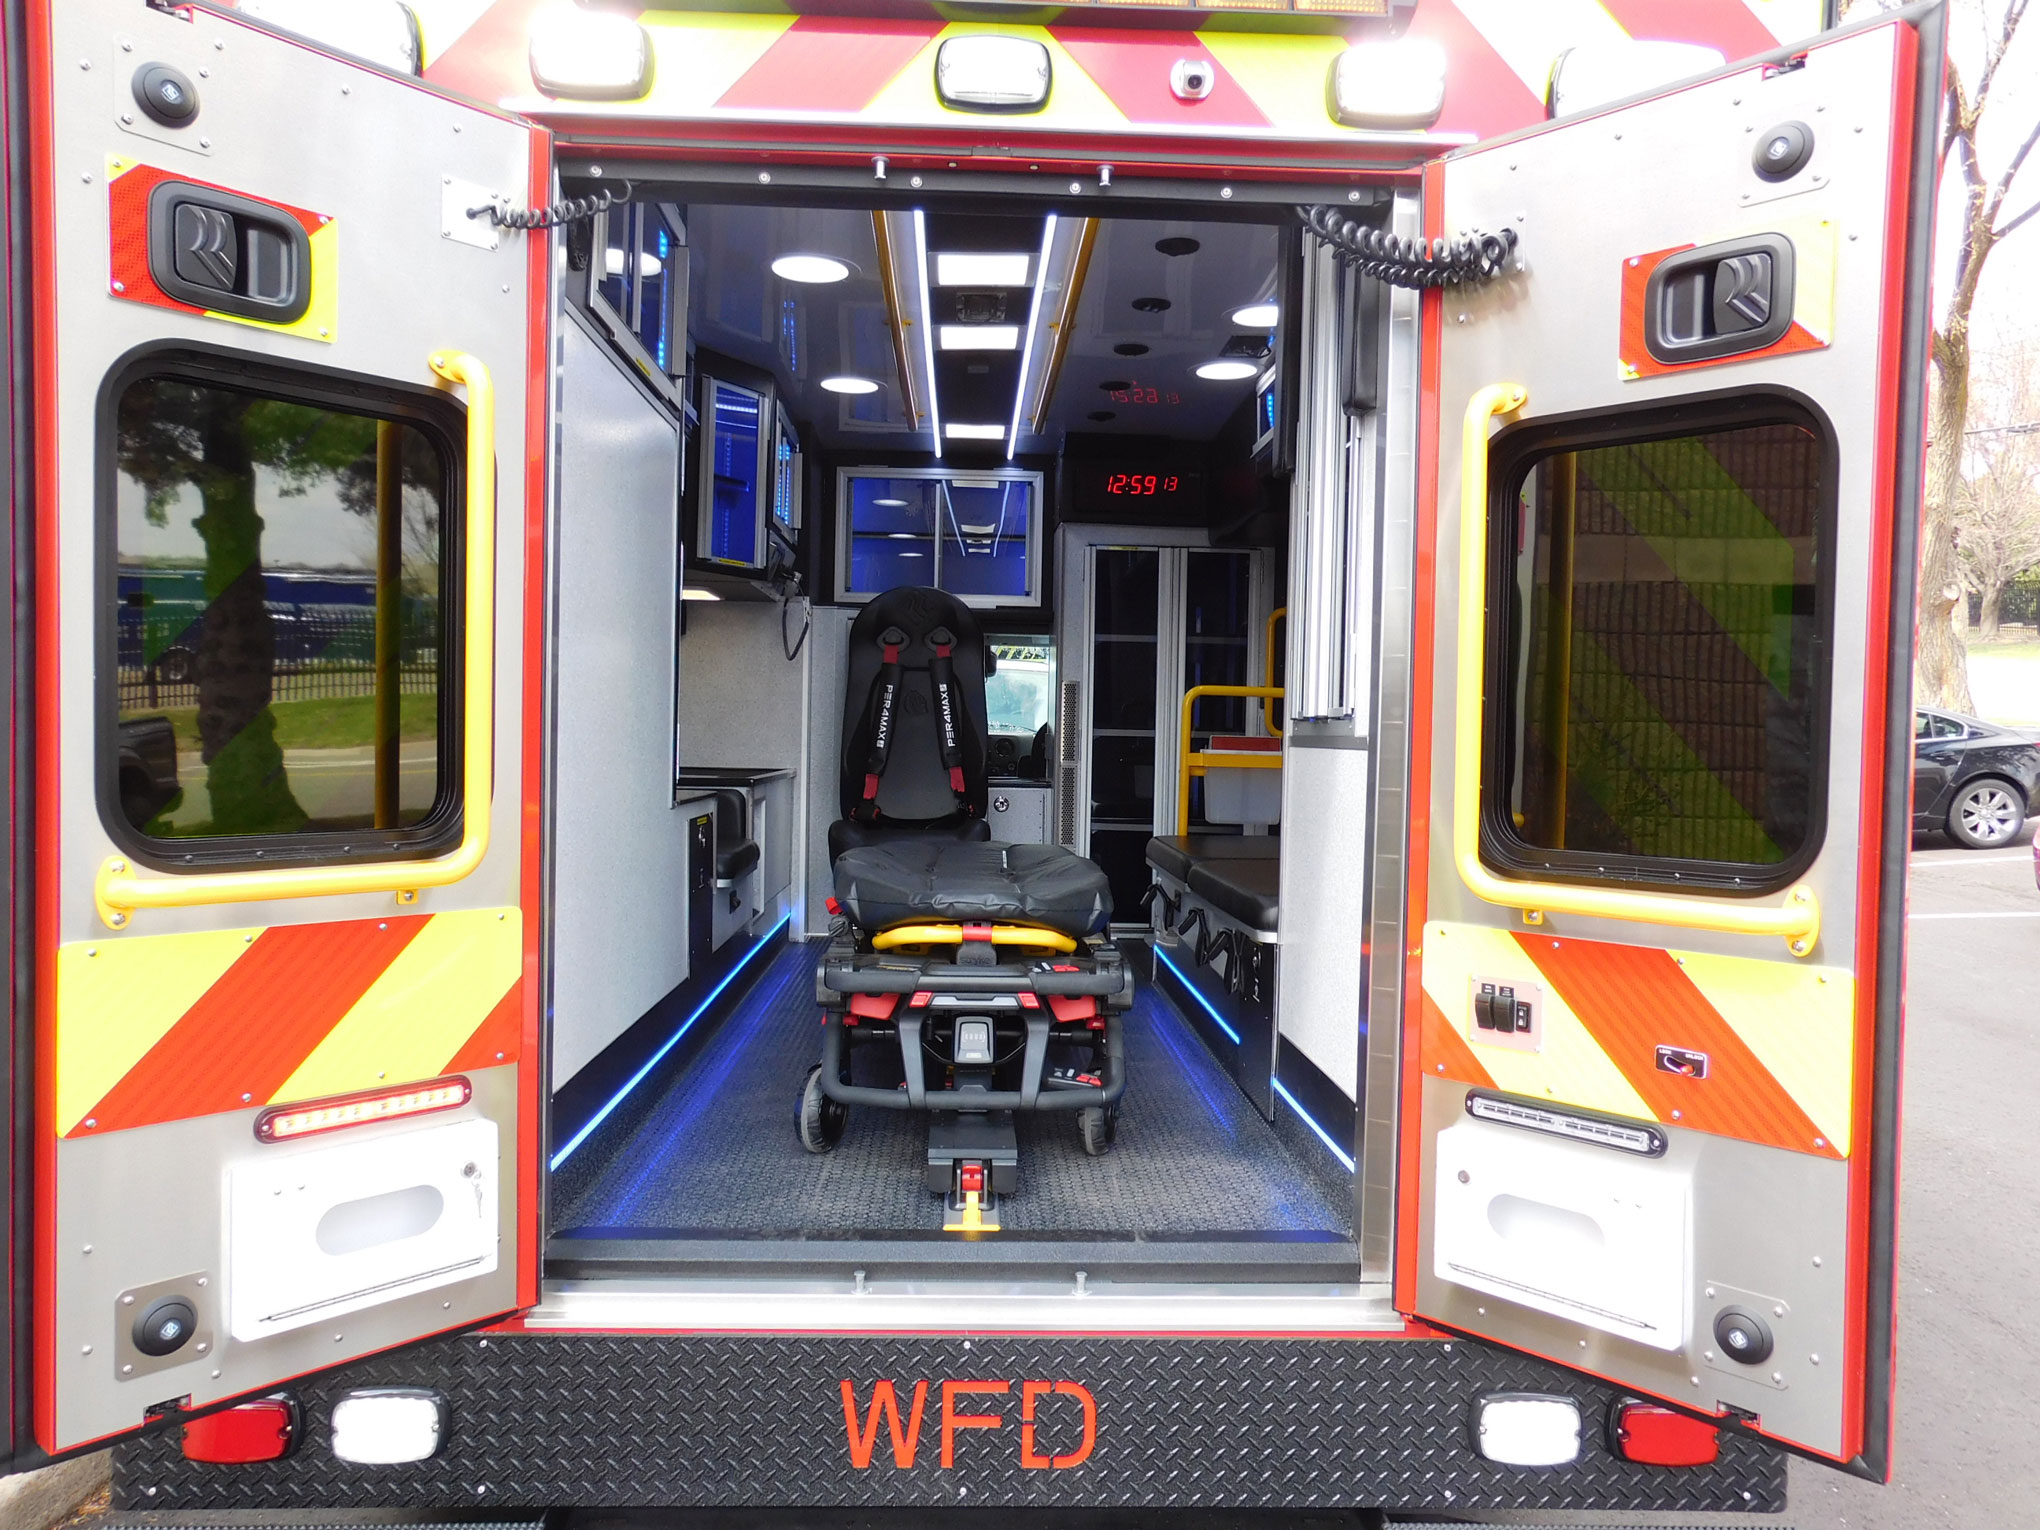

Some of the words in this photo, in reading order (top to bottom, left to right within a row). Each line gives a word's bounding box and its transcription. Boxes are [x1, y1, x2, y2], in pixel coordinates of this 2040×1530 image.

[1107, 474, 1157, 495] 12:59
[1163, 476, 1179, 491] 13
[840, 1380, 1096, 1468] WFD
